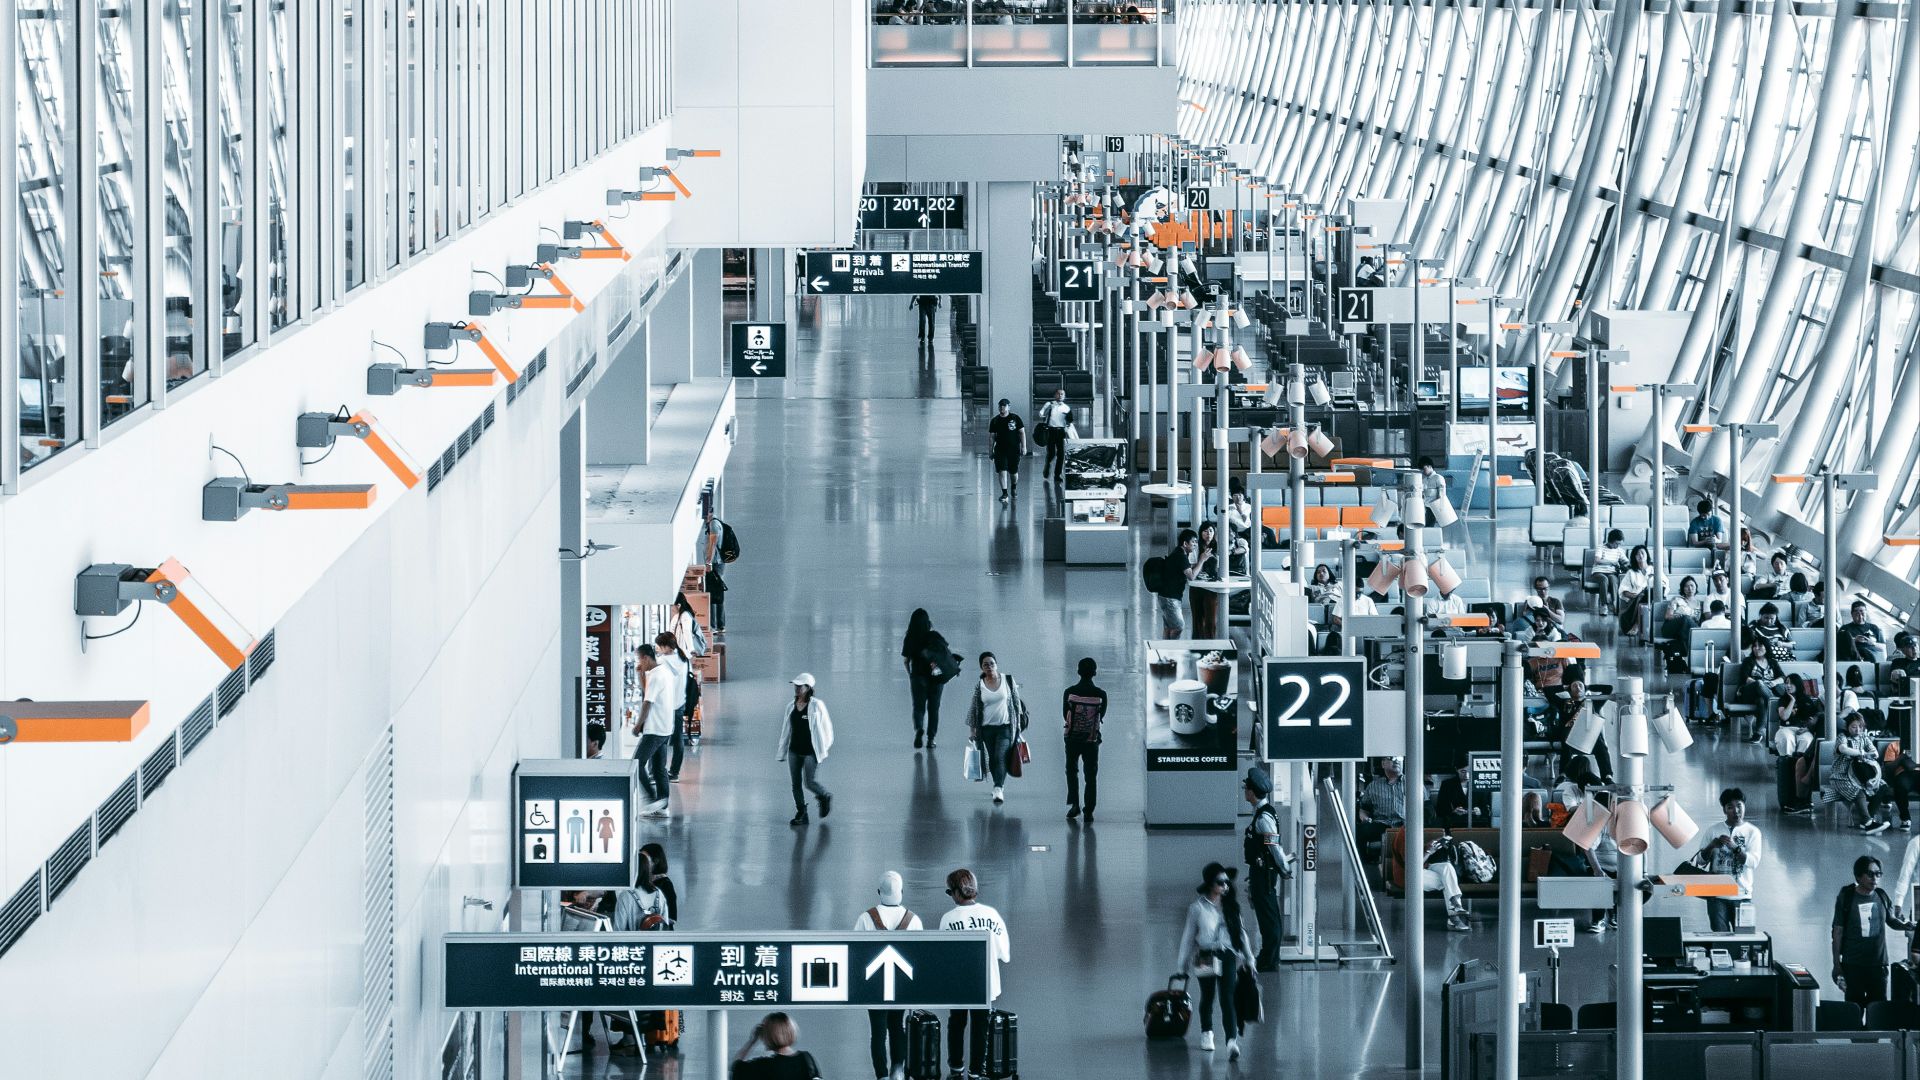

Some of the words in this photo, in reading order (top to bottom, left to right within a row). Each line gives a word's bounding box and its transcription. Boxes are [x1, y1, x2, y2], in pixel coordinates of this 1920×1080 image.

[1110, 138, 1122, 151] 19
[928, 198, 956, 211] 202
[1191, 189, 1207, 208] 20
[852, 268, 885, 276] Arrivals
[1064, 266, 1093, 288] 21
[1348, 293, 1369, 319] 21
[1278, 674, 1352, 727] 22
[1305, 839, 1316, 870] AED
[520, 946, 572, 962] 国際線
[578, 946, 647, 962] 乗り継ぎ
[514, 963, 593, 975] International
[596, 963, 647, 975] Transfer
[713, 969, 779, 986] Arrivals
[720, 990, 745, 1002] 到达
[753, 990, 779, 1002] 도착
